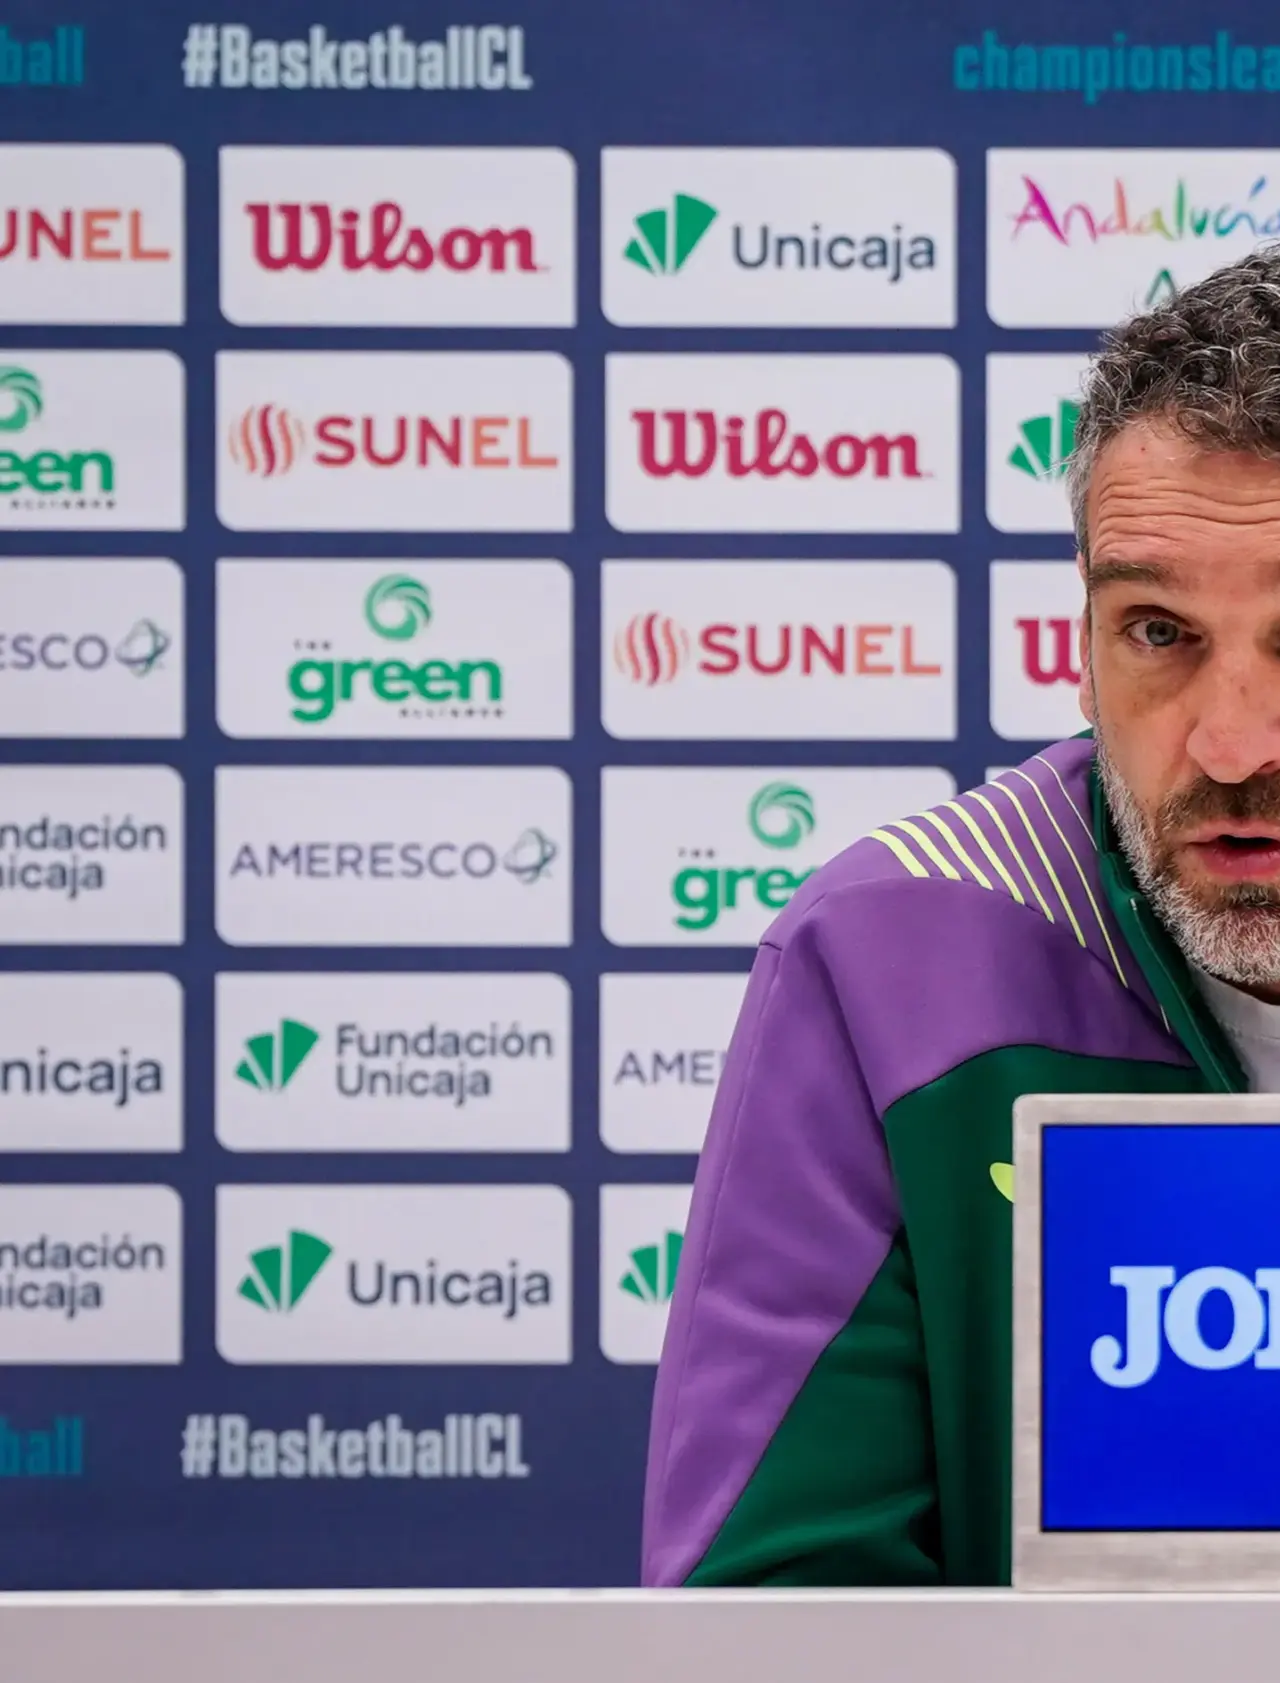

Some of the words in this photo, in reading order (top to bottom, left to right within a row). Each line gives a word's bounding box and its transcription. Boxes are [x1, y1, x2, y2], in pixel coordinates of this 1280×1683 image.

[182, 24, 533, 90] #BasketballCL
[245, 201, 540, 272] Wilson
[733, 224, 935, 283] Unicaja
[315, 416, 557, 468] SUNEL
[632, 408, 922, 479] Wilson
[699, 624, 941, 676] SUNEL
[288, 659, 502, 723] green
[229, 842, 497, 879] AMERESCO
[336, 1023, 553, 1059] Fundación
[336, 1062, 491, 1108] Unicaja
[348, 1260, 551, 1320] Unicaja
[181, 1413, 530, 1478] #BasketballCL
